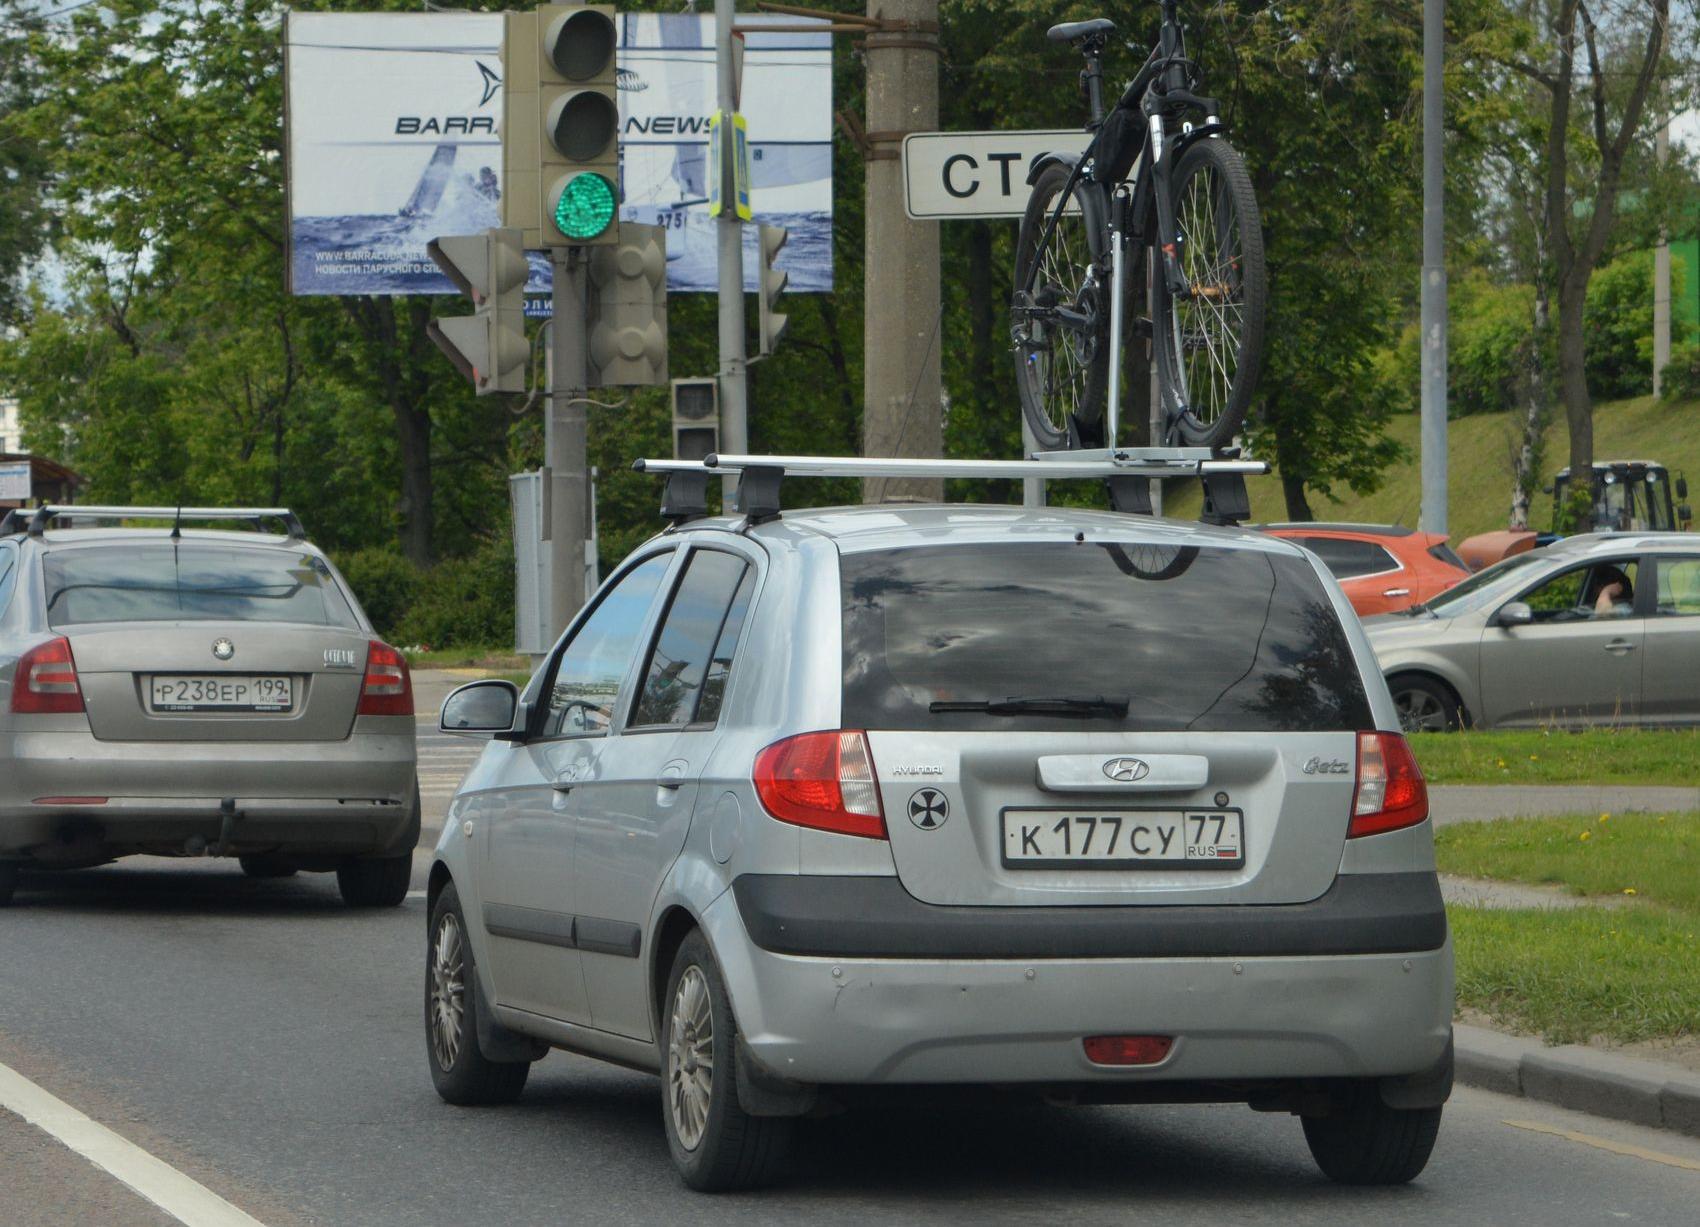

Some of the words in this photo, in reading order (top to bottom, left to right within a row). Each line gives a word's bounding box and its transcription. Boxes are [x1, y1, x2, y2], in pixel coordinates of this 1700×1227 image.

[395, 117, 499, 135] BARR
[942, 152, 1051, 198] СТ
[161, 681, 247, 701] Р238ЕР
[254, 679, 285, 696] 199
[1021, 817, 1176, 855] К177СУ
[1189, 815, 1226, 845] 77
[1188, 846, 1216, 857] RUS
